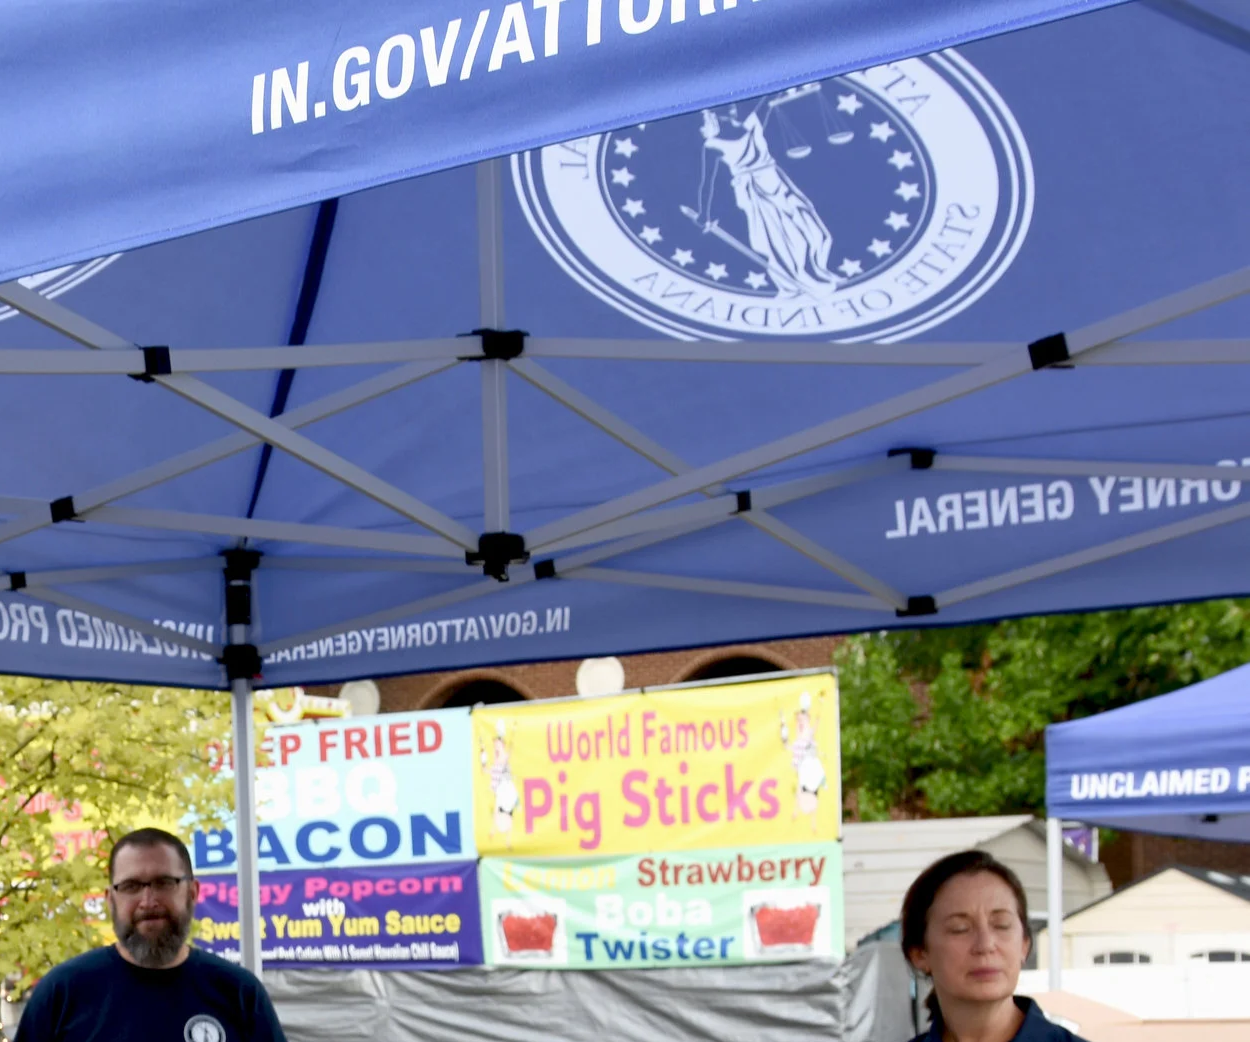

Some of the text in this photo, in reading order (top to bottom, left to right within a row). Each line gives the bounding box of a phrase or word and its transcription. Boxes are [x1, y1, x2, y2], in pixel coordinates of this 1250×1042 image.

[252, 0, 736, 134] IN.GOV/ATTO
[319, 720, 444, 762] FRIED
[547, 712, 749, 763] World Famous
[254, 761, 399, 822] BBQ
[1070, 766, 1231, 800] UNCLAIMED
[523, 761, 780, 850] Pig Sticks
[193, 811, 463, 870] BACON
[305, 875, 463, 902] Popcorn
[503, 853, 826, 892] Lemon Strawberry
[201, 910, 461, 941] Swet Yum Yum Sauce
[302, 898, 346, 918] with
[595, 893, 712, 929] Boba
[576, 931, 734, 962] Twister
